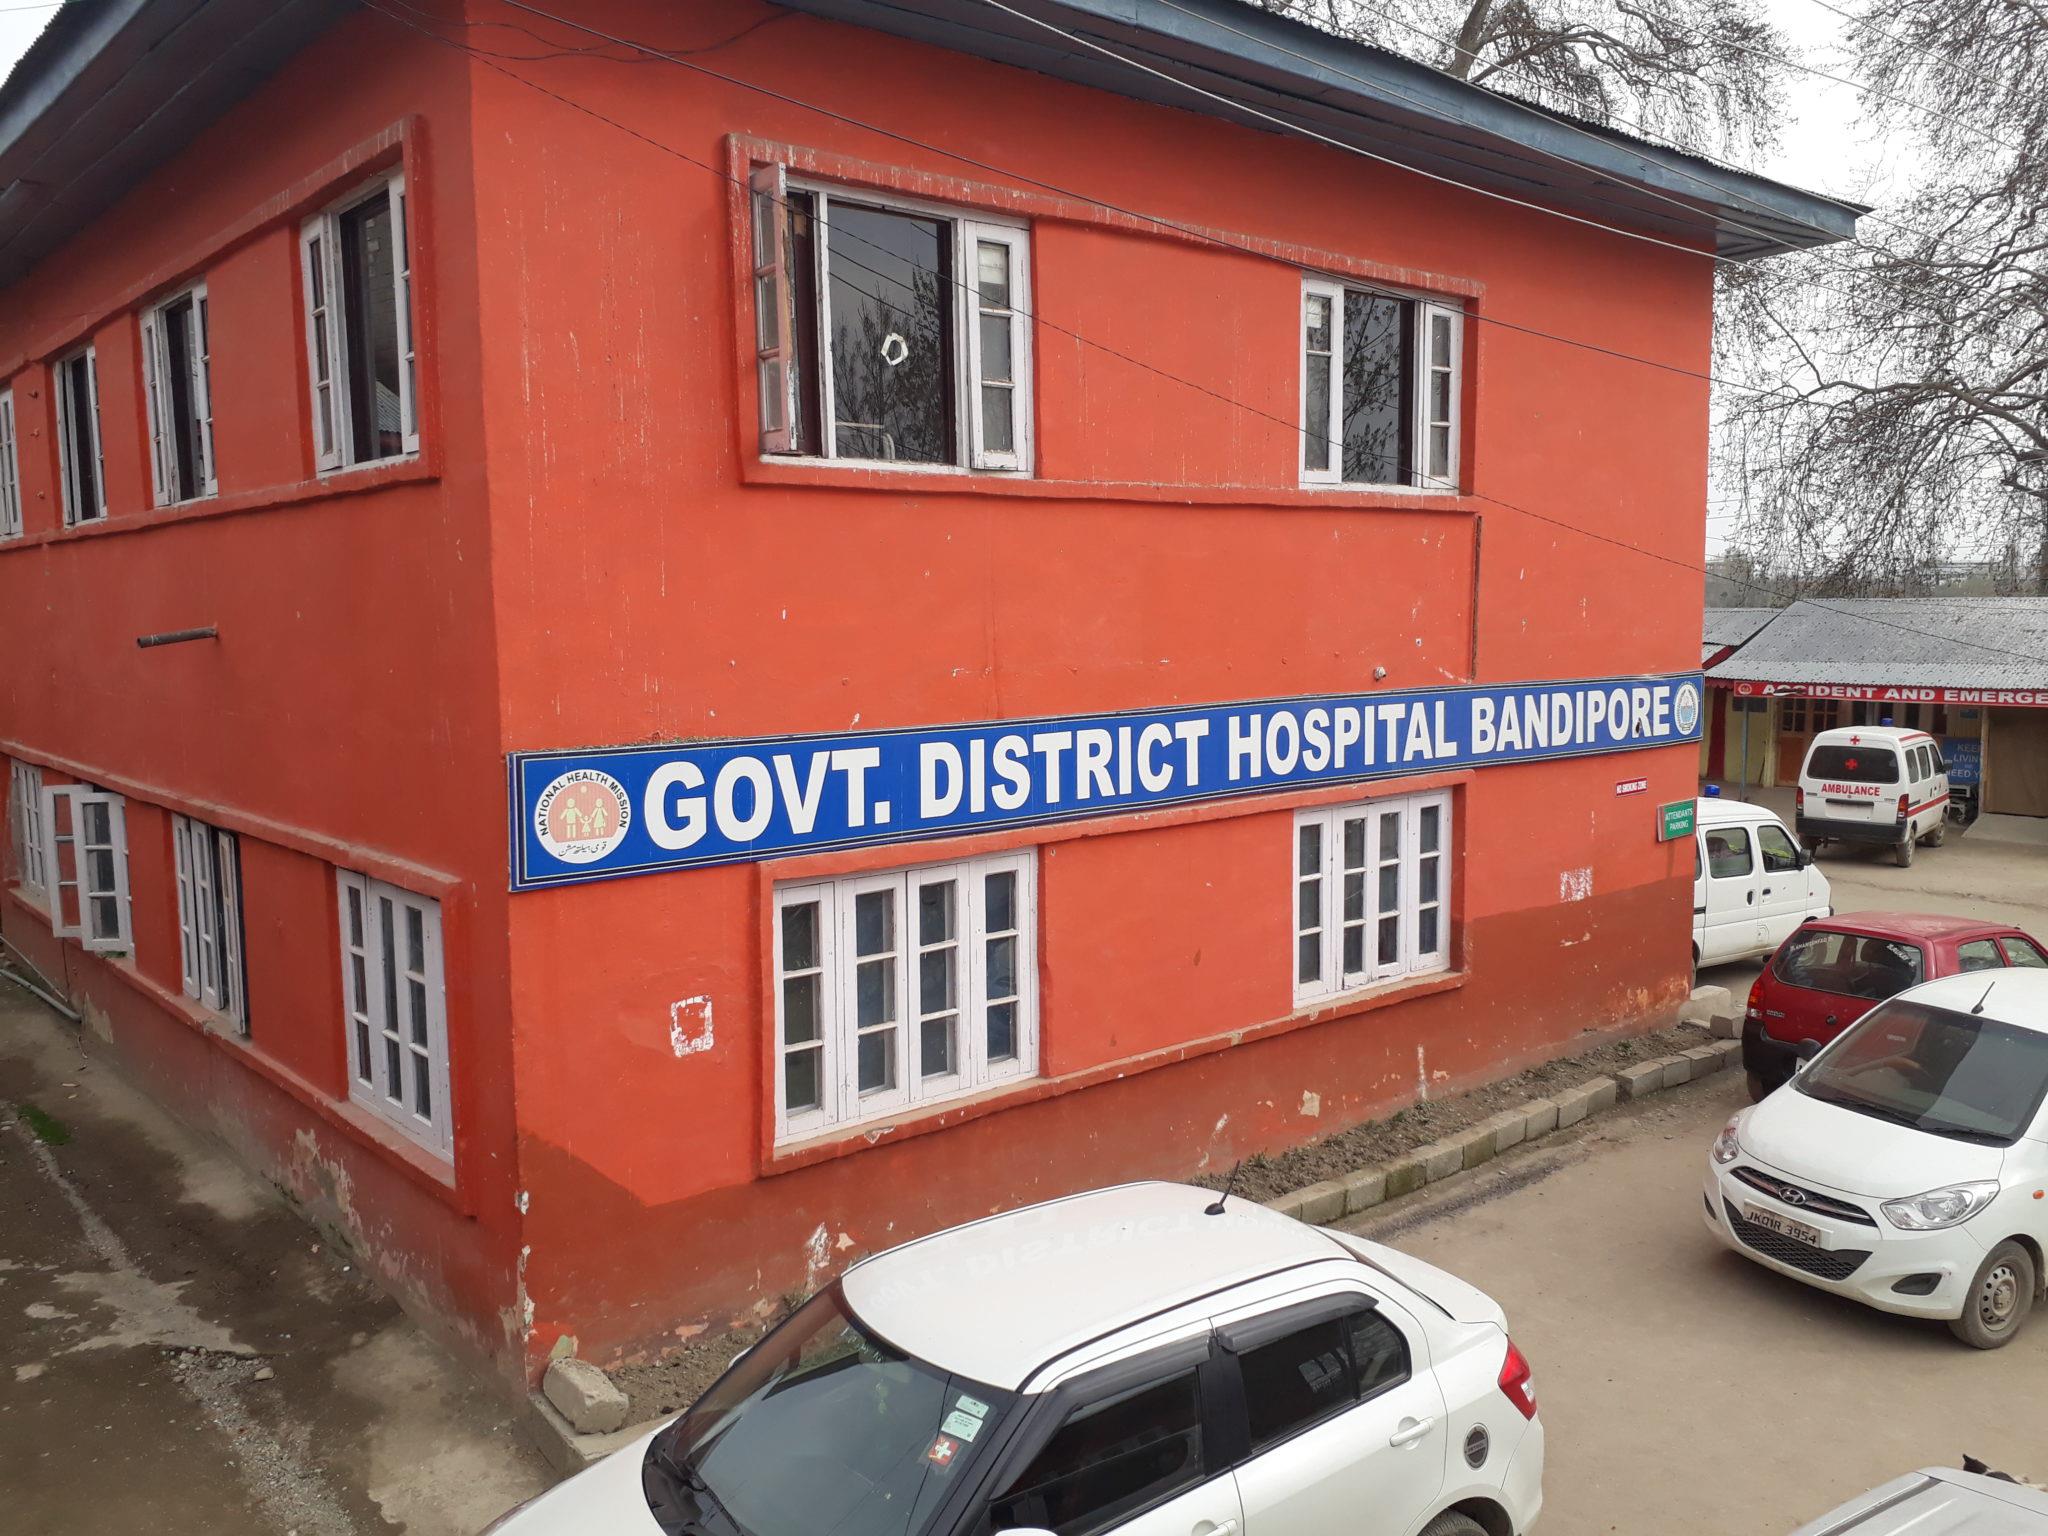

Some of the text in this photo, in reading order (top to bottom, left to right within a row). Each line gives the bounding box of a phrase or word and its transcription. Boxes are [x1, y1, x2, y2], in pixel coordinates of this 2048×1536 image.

[1884, 688, 1935, 701] AND
[1944, 690, 2048, 704] EMERGE
[1957, 744, 1981, 753] KEE
[643, 746, 891, 850] GOVT.
[919, 718, 1209, 819] DISTRICT
[1228, 700, 1457, 781] HOSPITAL
[1472, 686, 1671, 754] BANDIPORE
[1821, 783, 1881, 797] AMBULANCE
[538, 771, 629, 836] NATIONAL HEALTH MISSION
[1670, 820, 1689, 831] PARKING
[1785, 1224, 1817, 1245] 3954
